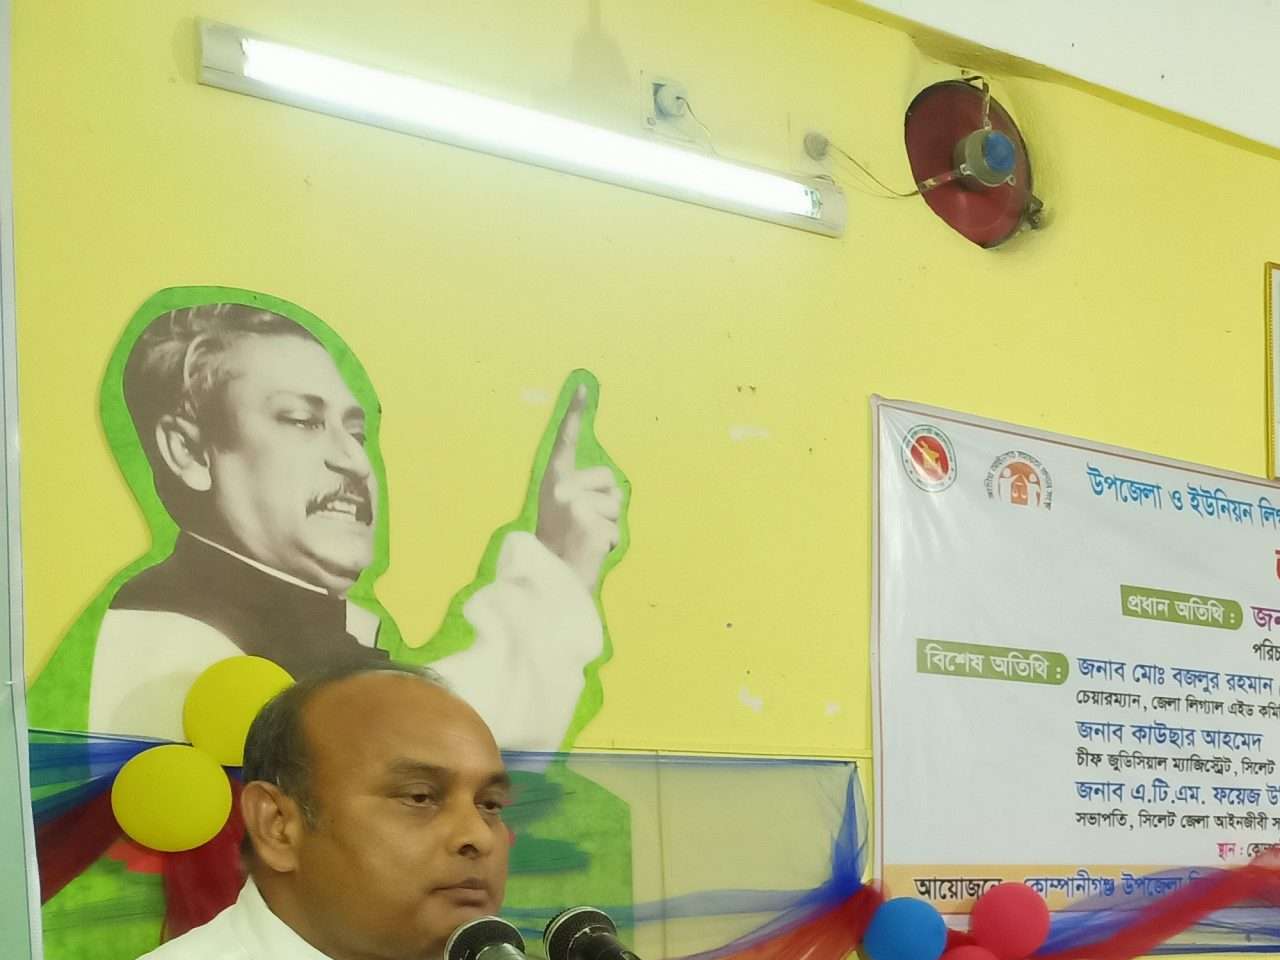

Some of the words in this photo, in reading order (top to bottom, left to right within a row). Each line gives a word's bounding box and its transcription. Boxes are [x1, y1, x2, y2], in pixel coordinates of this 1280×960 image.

[1087, 463, 1162, 510] উপজেলা
[1168, 490, 1183, 510] ও
[1187, 483, 1253, 523] ইউনিয়ন
[1127, 594, 1169, 616] প্রধান
[1174, 598, 1225, 624] অতিথি
[924, 643, 984, 673] বিশেষ
[990, 651, 1049, 679] অতিথি
[1077, 657, 1126, 682] জনাব
[1132, 664, 1165, 686] মোঃ
[1170, 667, 1222, 694] বজলুর
[1225, 673, 1274, 695] রহমান
[1151, 695, 1180, 713] জেলা
[1186, 694, 1224, 715] লিগ্যাল
[1228, 700, 1255, 717] এইড
[1075, 721, 1125, 744] জনাব
[1130, 720, 1197, 749] কাউছার
[1201, 730, 1265, 752] আহমেদ
[1076, 746, 1103, 768] চীফ
[1241, 757, 1276, 776] সিলেট
[1075, 781, 1125, 801] জনাব
[1212, 785, 1262, 806] ফয়েজ
[1138, 809, 1177, 828] সিলেট
[1180, 813, 1209, 829] জেলা
[1214, 811, 1269, 831] আইনজীবী
